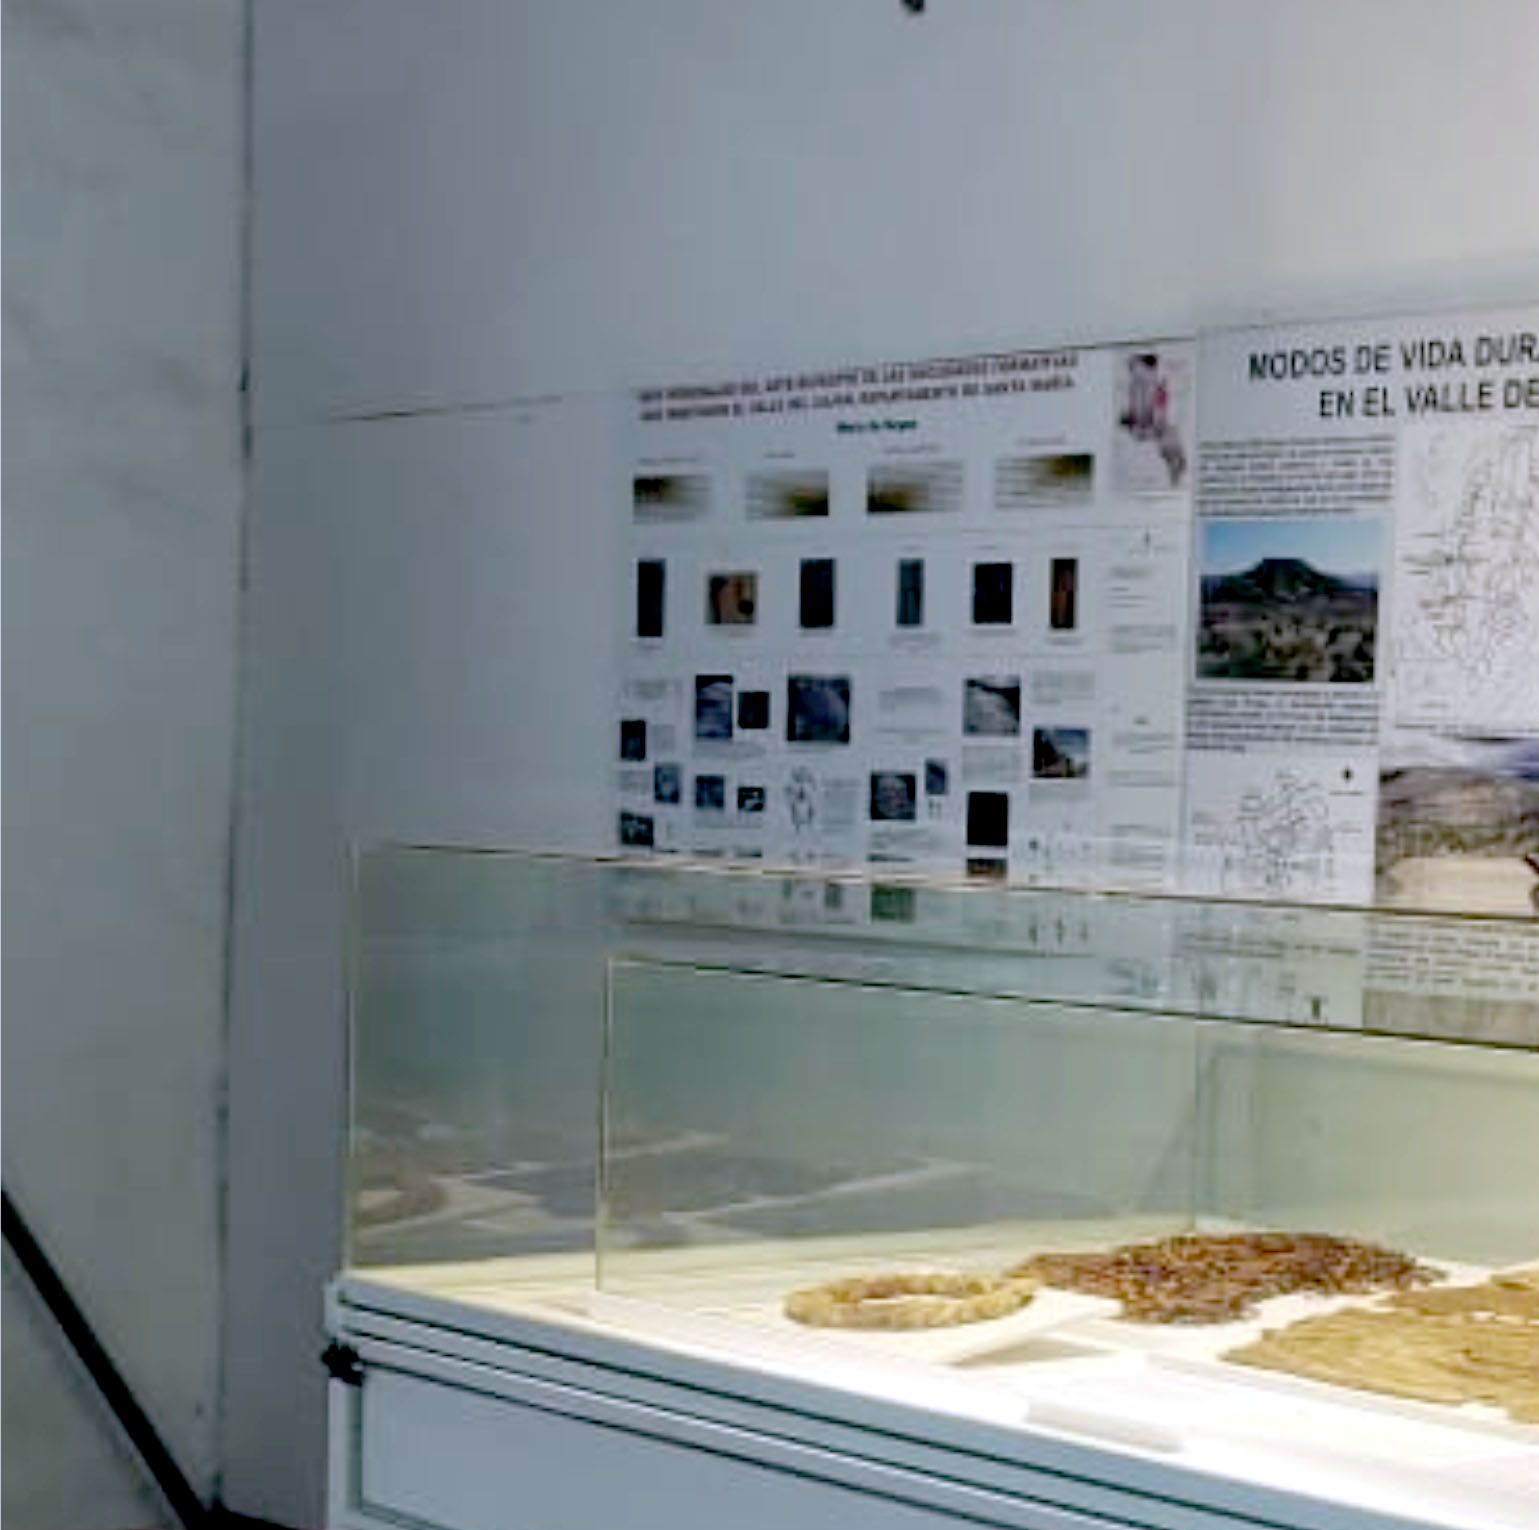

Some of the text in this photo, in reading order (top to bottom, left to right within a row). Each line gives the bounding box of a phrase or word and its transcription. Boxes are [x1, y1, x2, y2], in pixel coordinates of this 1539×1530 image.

[1248, 347, 1347, 380] MODOS
[1353, 344, 1393, 374] DE
[1400, 338, 1467, 371] VIDA
[1319, 389, 1354, 418] EN
[1361, 386, 1396, 416] EL
[1405, 381, 1494, 413] VALLE
